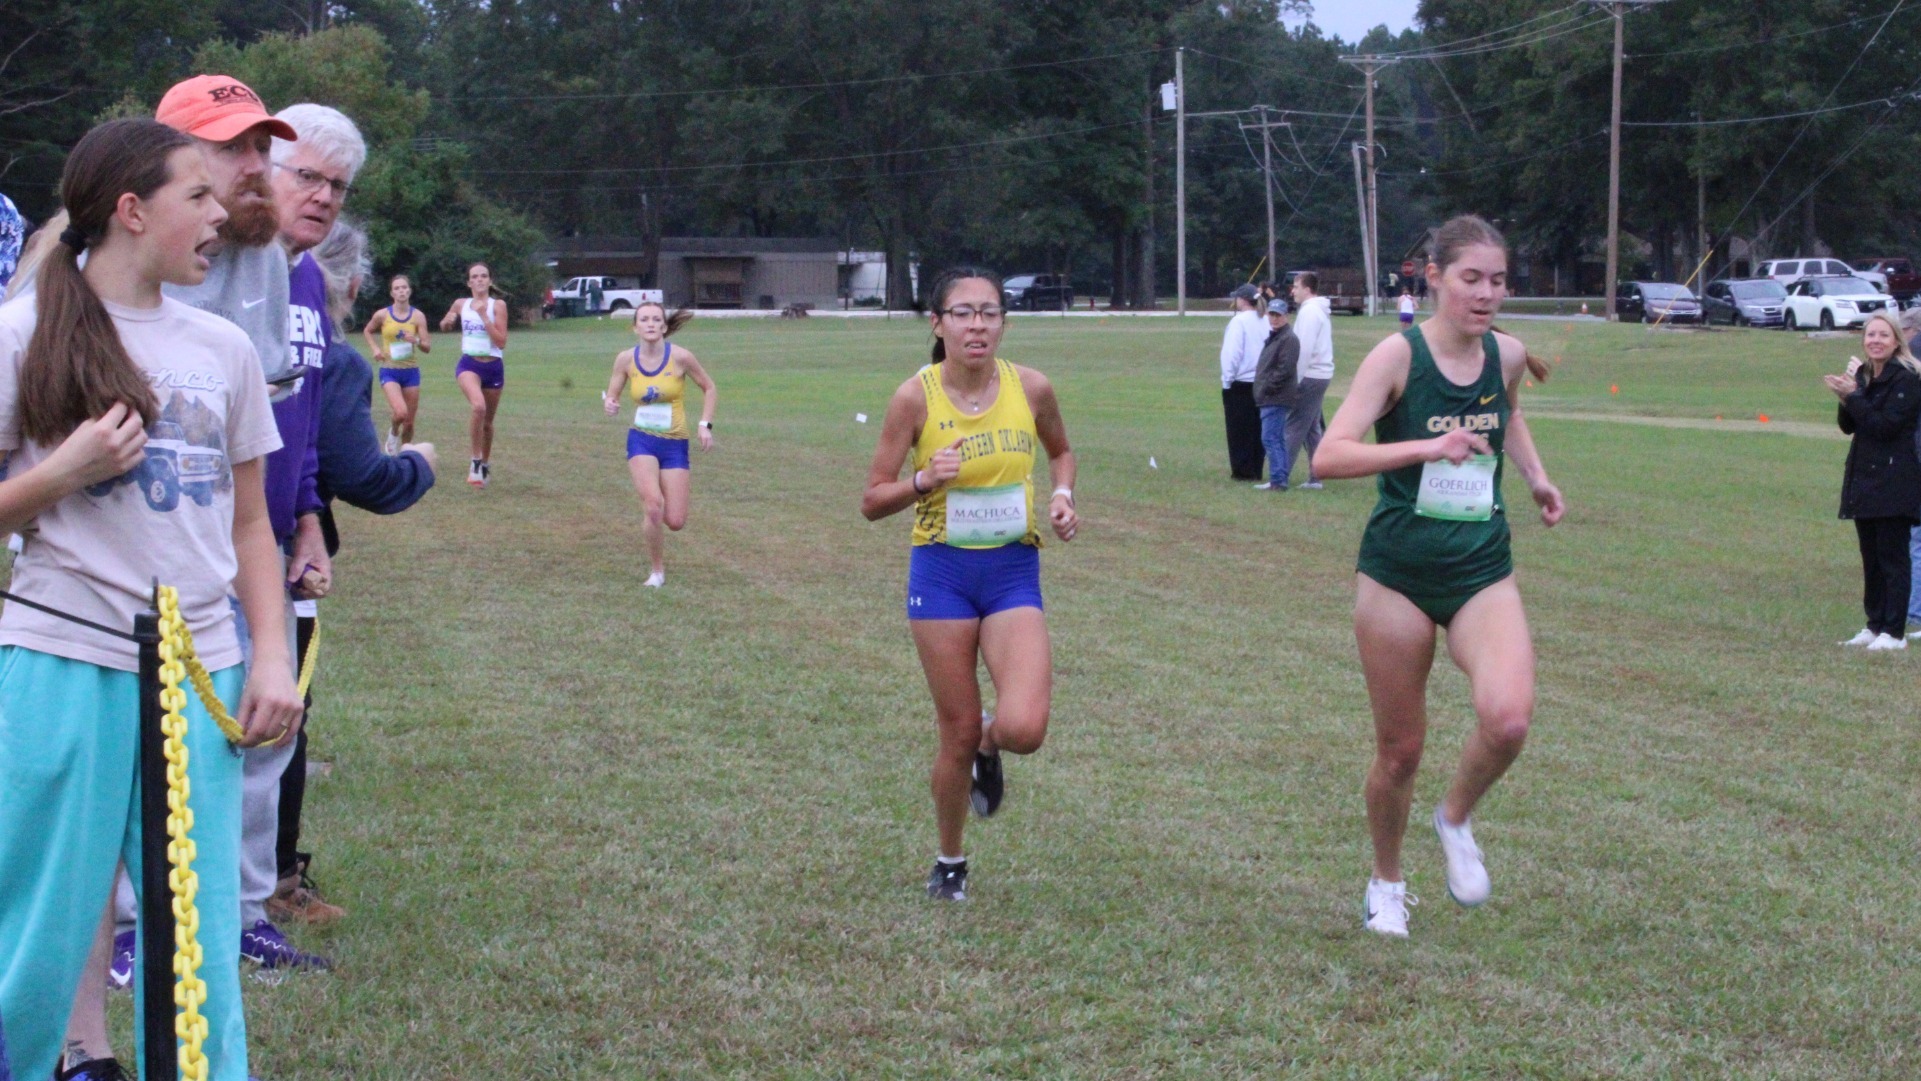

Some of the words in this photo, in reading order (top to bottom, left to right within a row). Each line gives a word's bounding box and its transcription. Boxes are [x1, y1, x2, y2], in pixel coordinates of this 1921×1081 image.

[303, 346, 323, 369] FIEL
[1427, 412, 1499, 432] GOLDEN
[960, 432, 995, 462] ASTERN
[1429, 477, 1487, 491] GOERLICH
[954, 506, 1020, 519] MACHUCA
